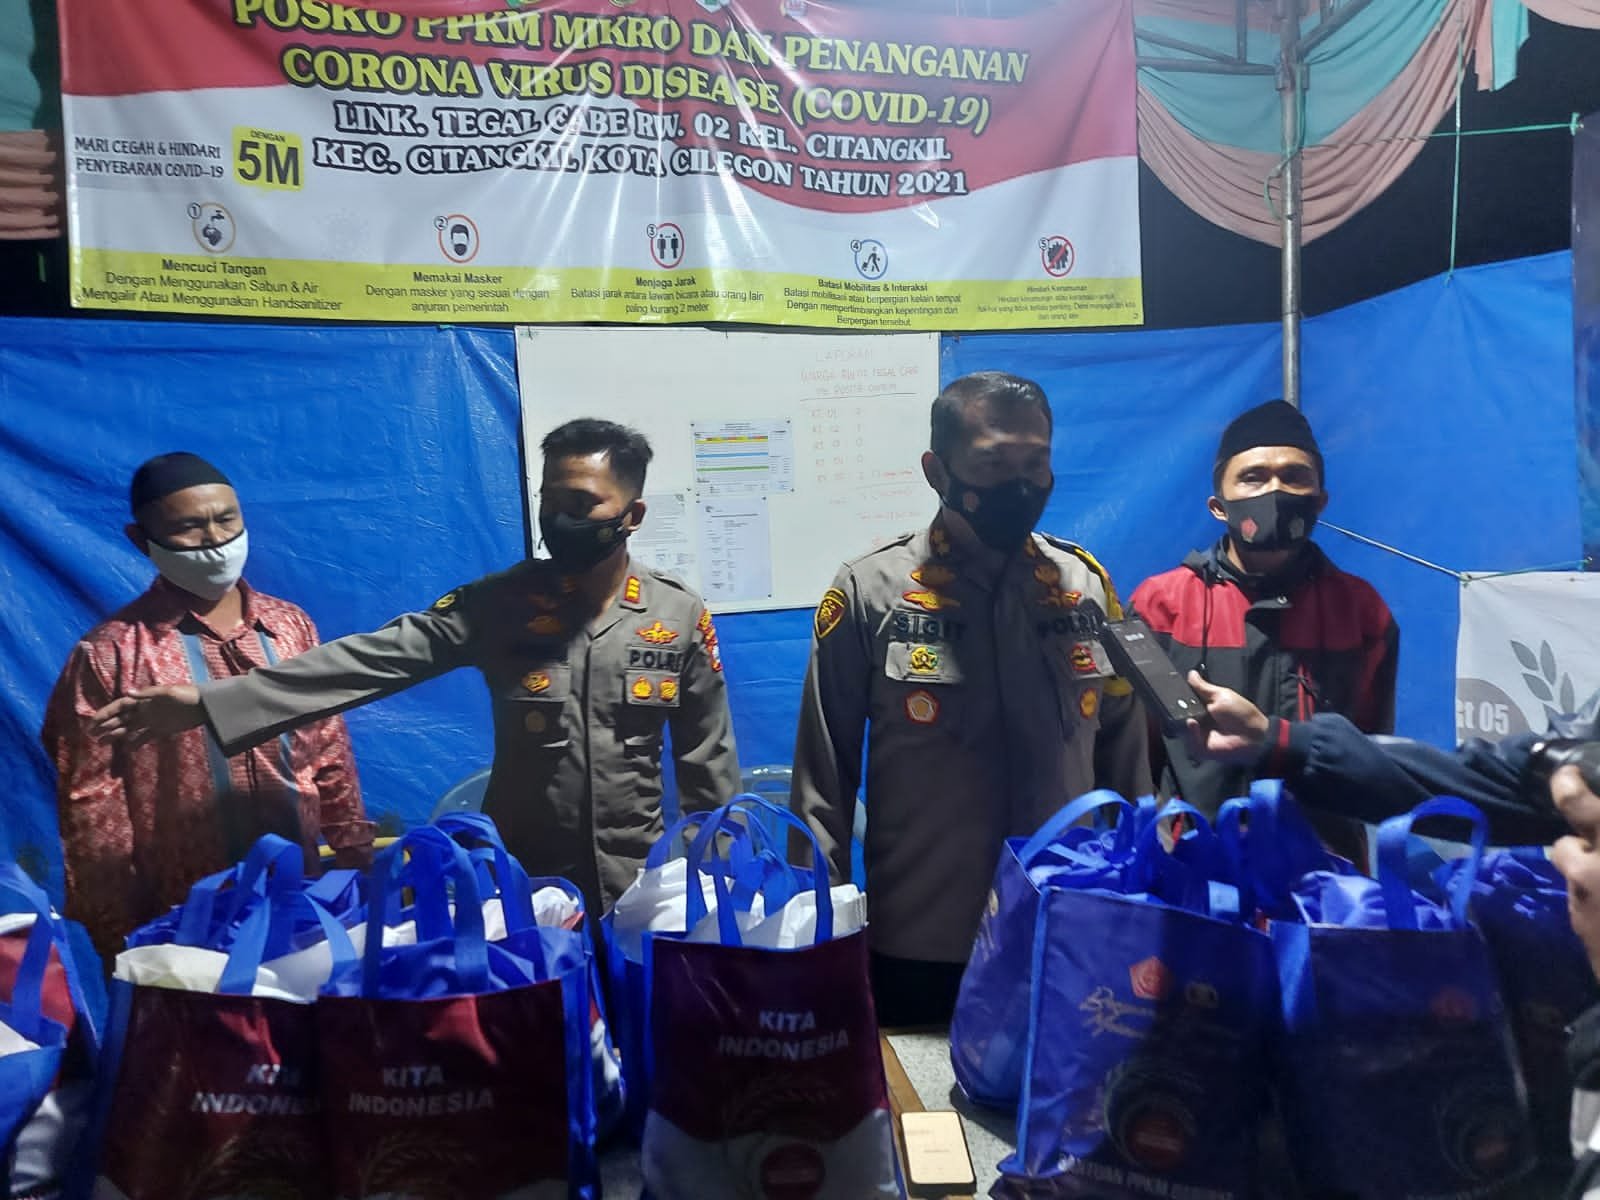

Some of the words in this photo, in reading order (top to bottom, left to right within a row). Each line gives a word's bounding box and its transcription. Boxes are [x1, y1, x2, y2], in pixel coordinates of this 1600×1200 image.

[233, 0, 403, 36] POSKO
[415, 10, 541, 46] PPKM
[552, 14, 682, 50] MIKRO
[691, 22, 775, 66] DAN
[784, 35, 1029, 83] PENANGANAN
[282, 47, 481, 95] CORONA
[488, 61, 613, 98] VIRUS
[622, 64, 780, 115] DISEASE
[792, 86, 990, 136] (COVID-19)
[250, 131, 285, 143] DENGAN
[335, 102, 428, 136] LINK.
[434, 109, 540, 137] TEGAL
[547, 104, 630, 137] CABE
[635, 111, 685, 140] RW.
[694, 113, 731, 140] 02
[738, 124, 799, 153] KEL.
[806, 133, 952, 162] CITANGKIL
[75, 137, 109, 153] MARI
[111, 140, 155, 157] CEGAH
[158, 142, 166, 156] &
[169, 142, 221, 159] HINDARI
[75, 157, 163, 177] PENYEBARAN
[164, 163, 224, 179] COVID-19
[238, 140, 301, 187] 5M
[313, 139, 402, 174] KEC.
[407, 140, 579, 173] CITANGKIL
[582, 144, 667, 177] KOTA
[670, 150, 793, 186] CILEGON
[800, 166, 890, 196] TAHUN
[898, 172, 970, 196] 2021
[162, 259, 217, 274] Mencuci
[221, 262, 266, 278] Tangan
[413, 271, 462, 284] Memakai
[464, 272, 502, 285] Masker
[105, 271, 156, 289] Dengan
[159, 275, 247, 293] Menggunakan
[250, 279, 287, 294] Sabun
[291, 282, 299, 294] &
[302, 281, 319, 295] Air
[365, 285, 408, 299] Dengan
[409, 287, 447, 298] masker
[450, 289, 476, 301] yang
[478, 288, 511, 299] sesuai
[635, 276, 673, 289] Menjaga
[674, 276, 697, 287] Jarak
[784, 287, 809, 298] Batasi
[817, 278, 842, 290] Batasi
[844, 281, 881, 292] Mobilitas
[883, 284, 890, 293] &
[891, 283, 928, 293] Interaksi
[142, 291, 169, 304] Atau
[172, 293, 258, 309] Menggunakan
[571, 287, 600, 299] Batasi
[749, 290, 764, 301] lain
[411, 301, 451, 314] anjuran
[452, 302, 509, 314] pemerintah
[786, 299, 818, 312] Dengan
[1478, 702, 1510, 735] 05
[759, 1008, 817, 1033] KITA
[717, 1029, 849, 1061] INDONESIA
[382, 1065, 445, 1087] KITA
[347, 1089, 495, 1116] INDONESIA
